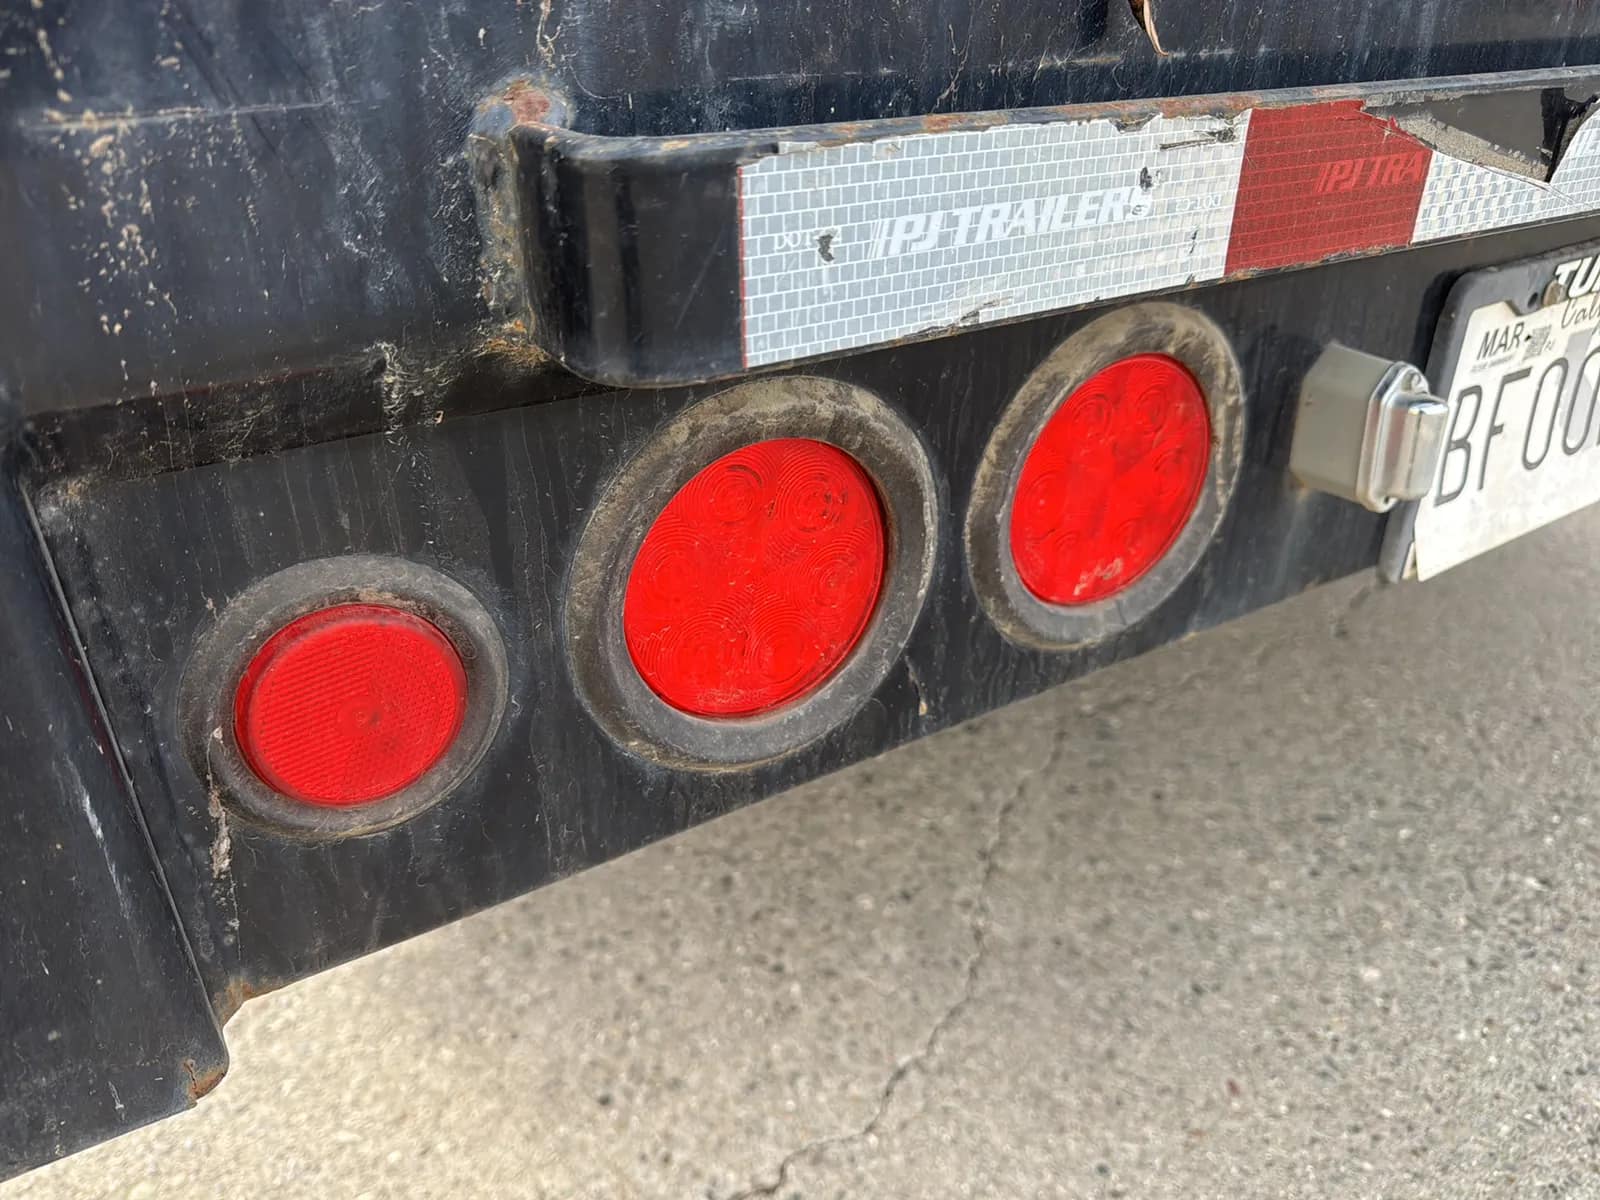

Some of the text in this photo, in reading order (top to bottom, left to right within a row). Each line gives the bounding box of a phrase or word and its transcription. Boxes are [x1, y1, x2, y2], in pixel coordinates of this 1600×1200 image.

[952, 185, 1153, 247] TRAILERS
[1554, 253, 1600, 299] TU
[1476, 321, 1525, 361] MAR
[1433, 346, 1600, 508] BF00
